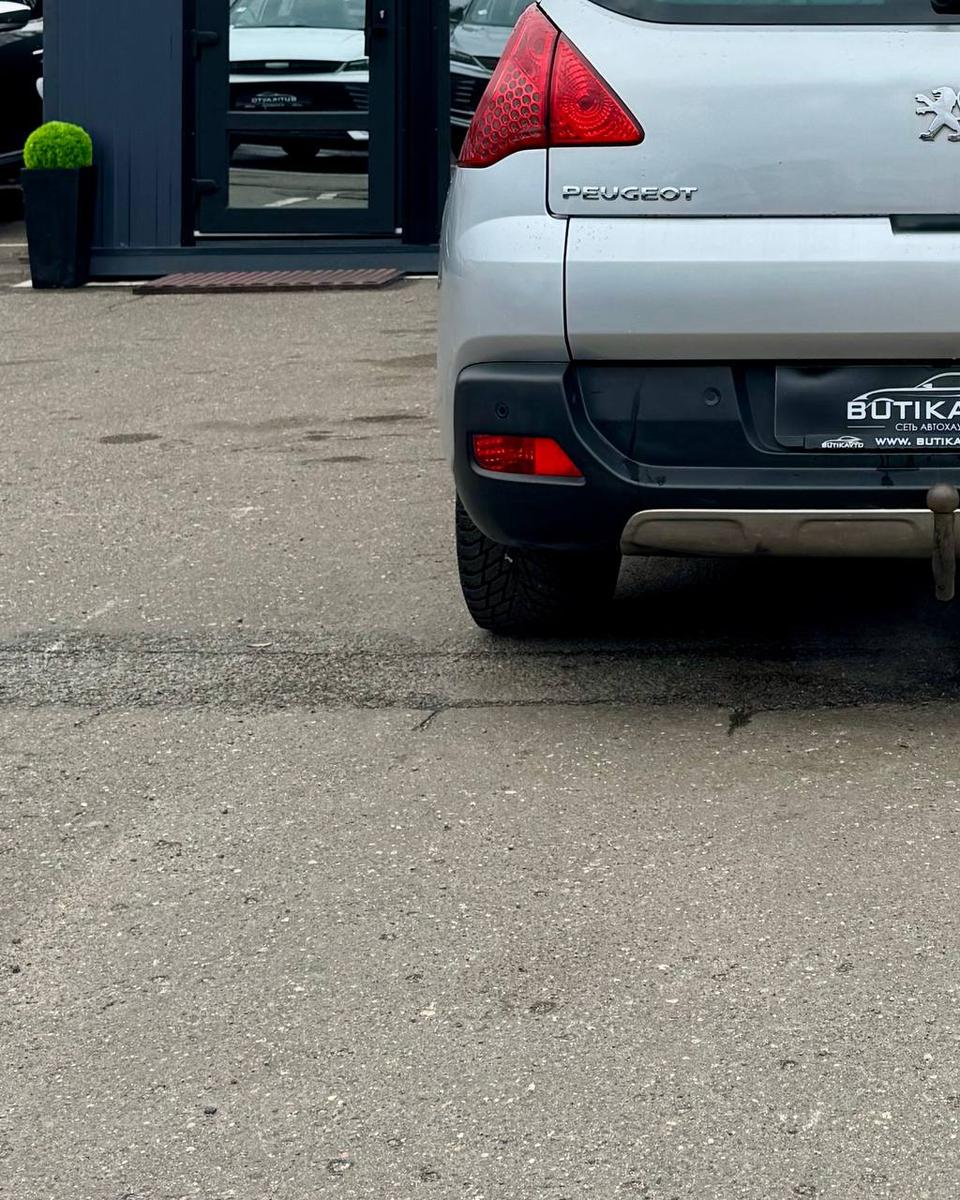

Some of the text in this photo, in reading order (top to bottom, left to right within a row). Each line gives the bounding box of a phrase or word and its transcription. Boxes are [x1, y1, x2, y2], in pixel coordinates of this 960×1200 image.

[562, 185, 698, 201] PEUGEOT
[895, 423, 917, 432] СЕТЬ
[875, 437, 911, 446] WWW.
